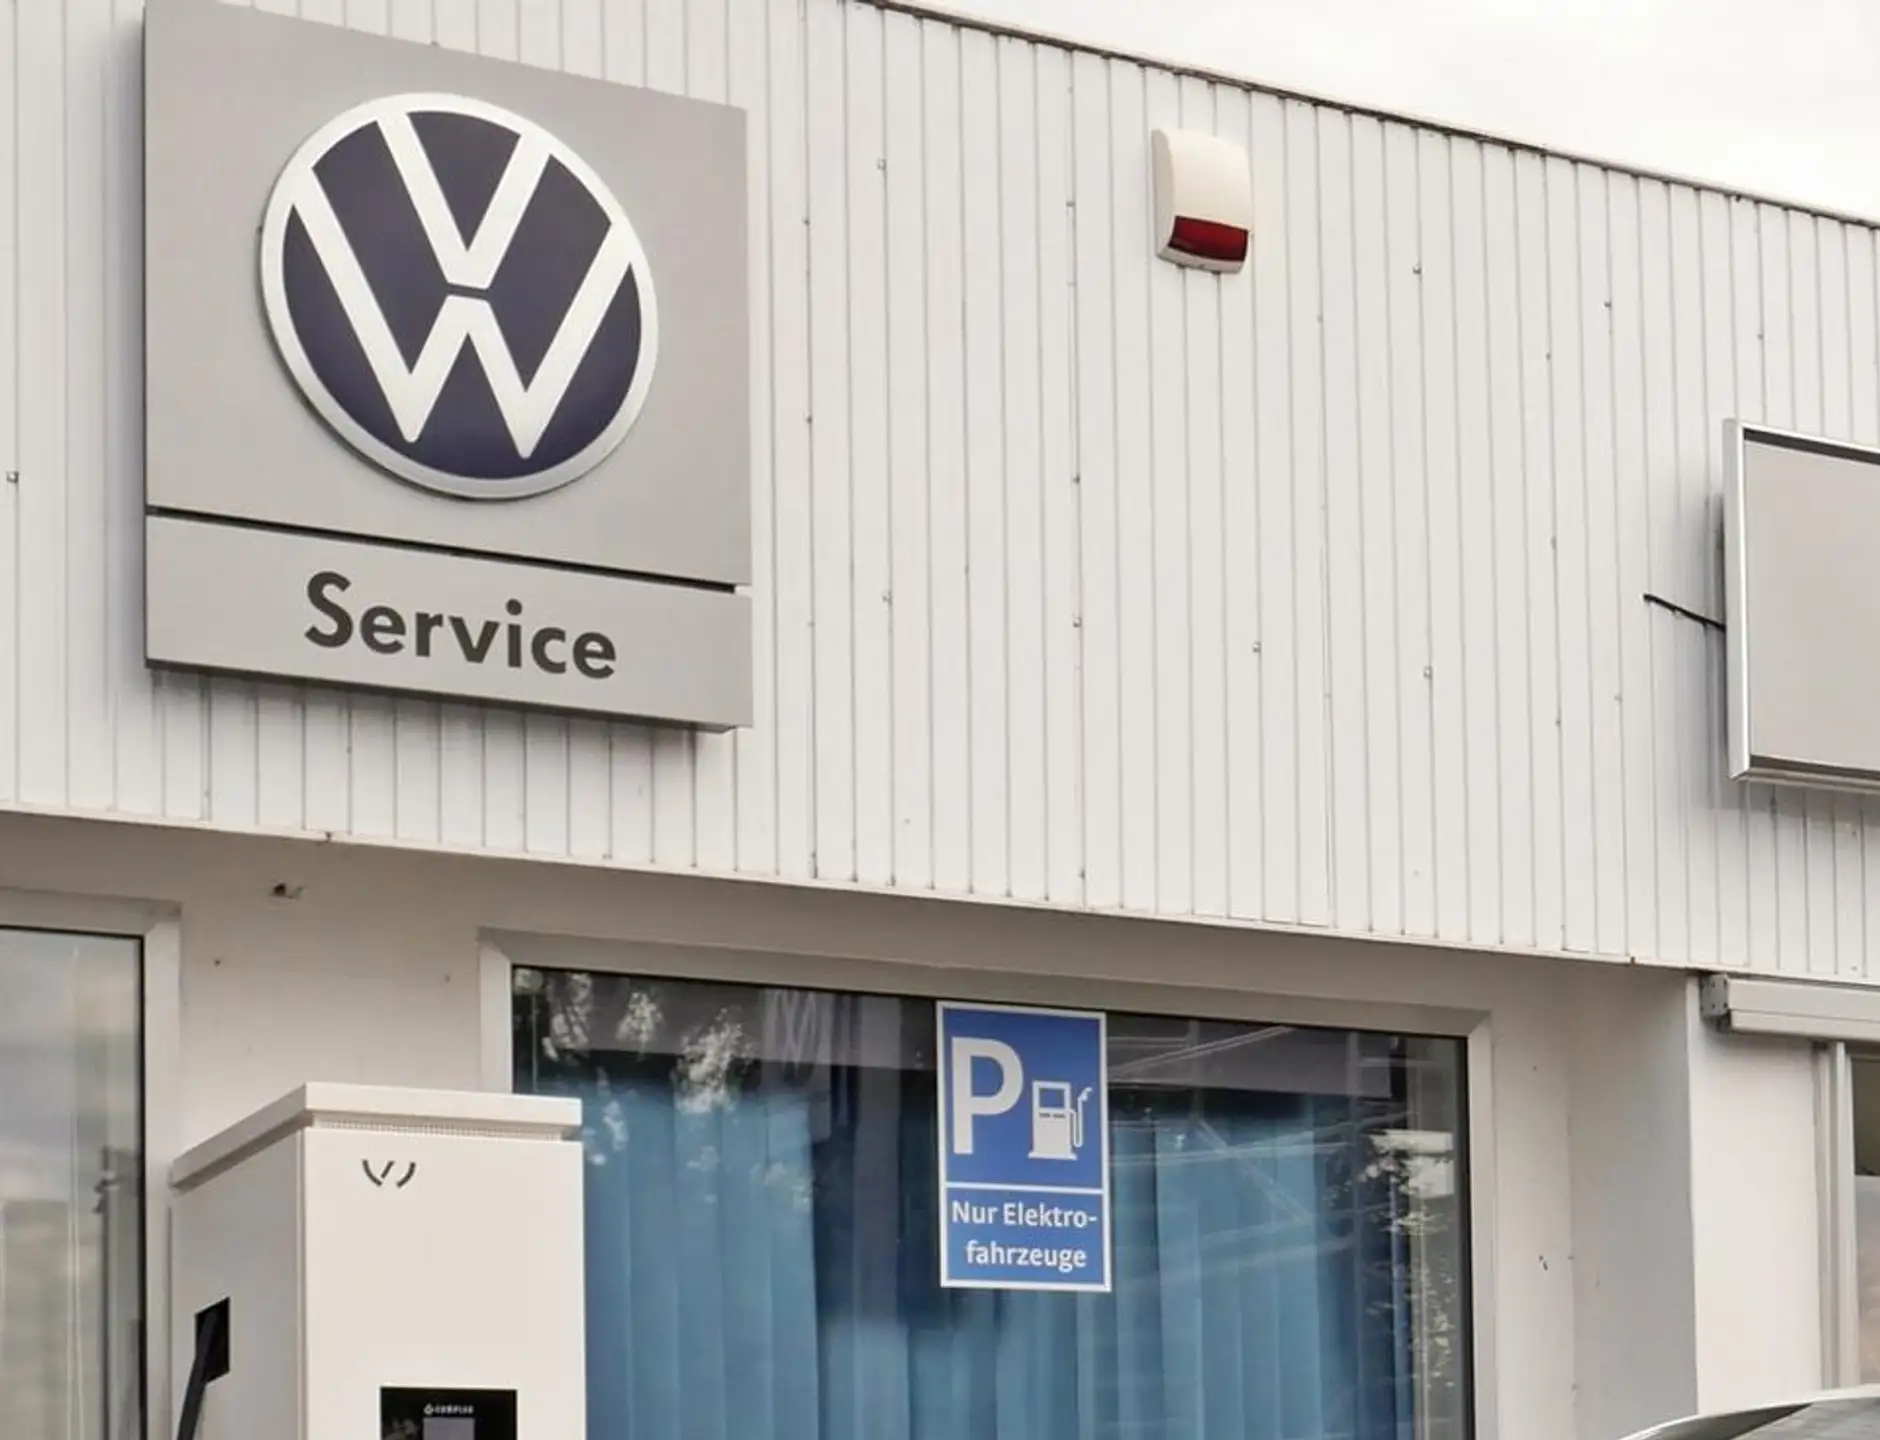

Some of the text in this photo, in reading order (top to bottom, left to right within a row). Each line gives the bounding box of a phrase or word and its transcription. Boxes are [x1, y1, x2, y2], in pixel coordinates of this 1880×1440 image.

[268, 97, 652, 485] VW
[305, 570, 617, 680] Service
[951, 1036, 1024, 1155] P
[952, 1201, 1098, 1228] Nur Elektro-
[965, 1240, 1087, 1273] fahrzeuge
